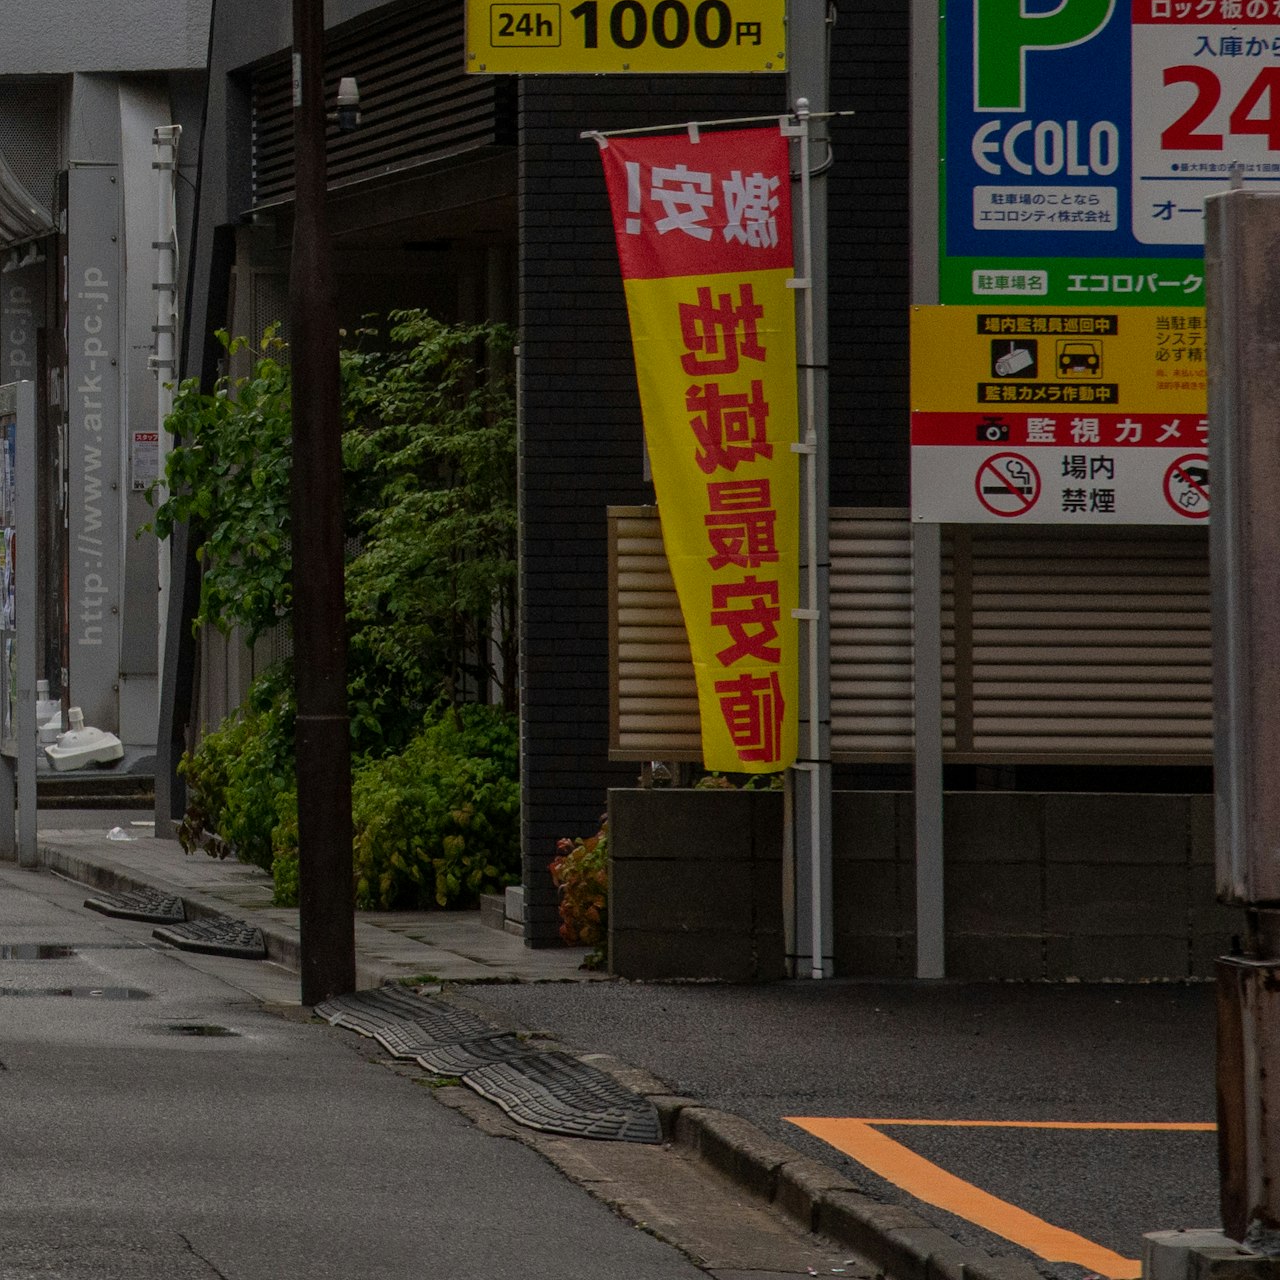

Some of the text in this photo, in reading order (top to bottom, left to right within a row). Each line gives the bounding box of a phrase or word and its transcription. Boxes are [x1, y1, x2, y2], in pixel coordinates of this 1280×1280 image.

[498, 0, 762, 48] 24h 1000円
[971, 119, 1119, 176] ECOLO
[991, 192, 1100, 207] 駐車場のことなら
[979, 209, 1111, 224] エコロシティ株式会社
[1152, 200, 1205, 220] オー
[977, 275, 1043, 290] 駐車場名
[1067, 274, 1204, 295] エコロパーク
[984, 316, 1111, 333] 場内監視員巡回中
[1155, 316, 1207, 330] 当駐車
[1155, 332, 1207, 346] システ
[1155, 347, 1207, 362] 必ず精
[985, 385, 1112, 402] 監視カメラ作動中
[78, 266, 109, 646] http://www.ark-pc.jp
[1061, 454, 1115, 480] 場内
[1061, 488, 1115, 514] 禁煙
